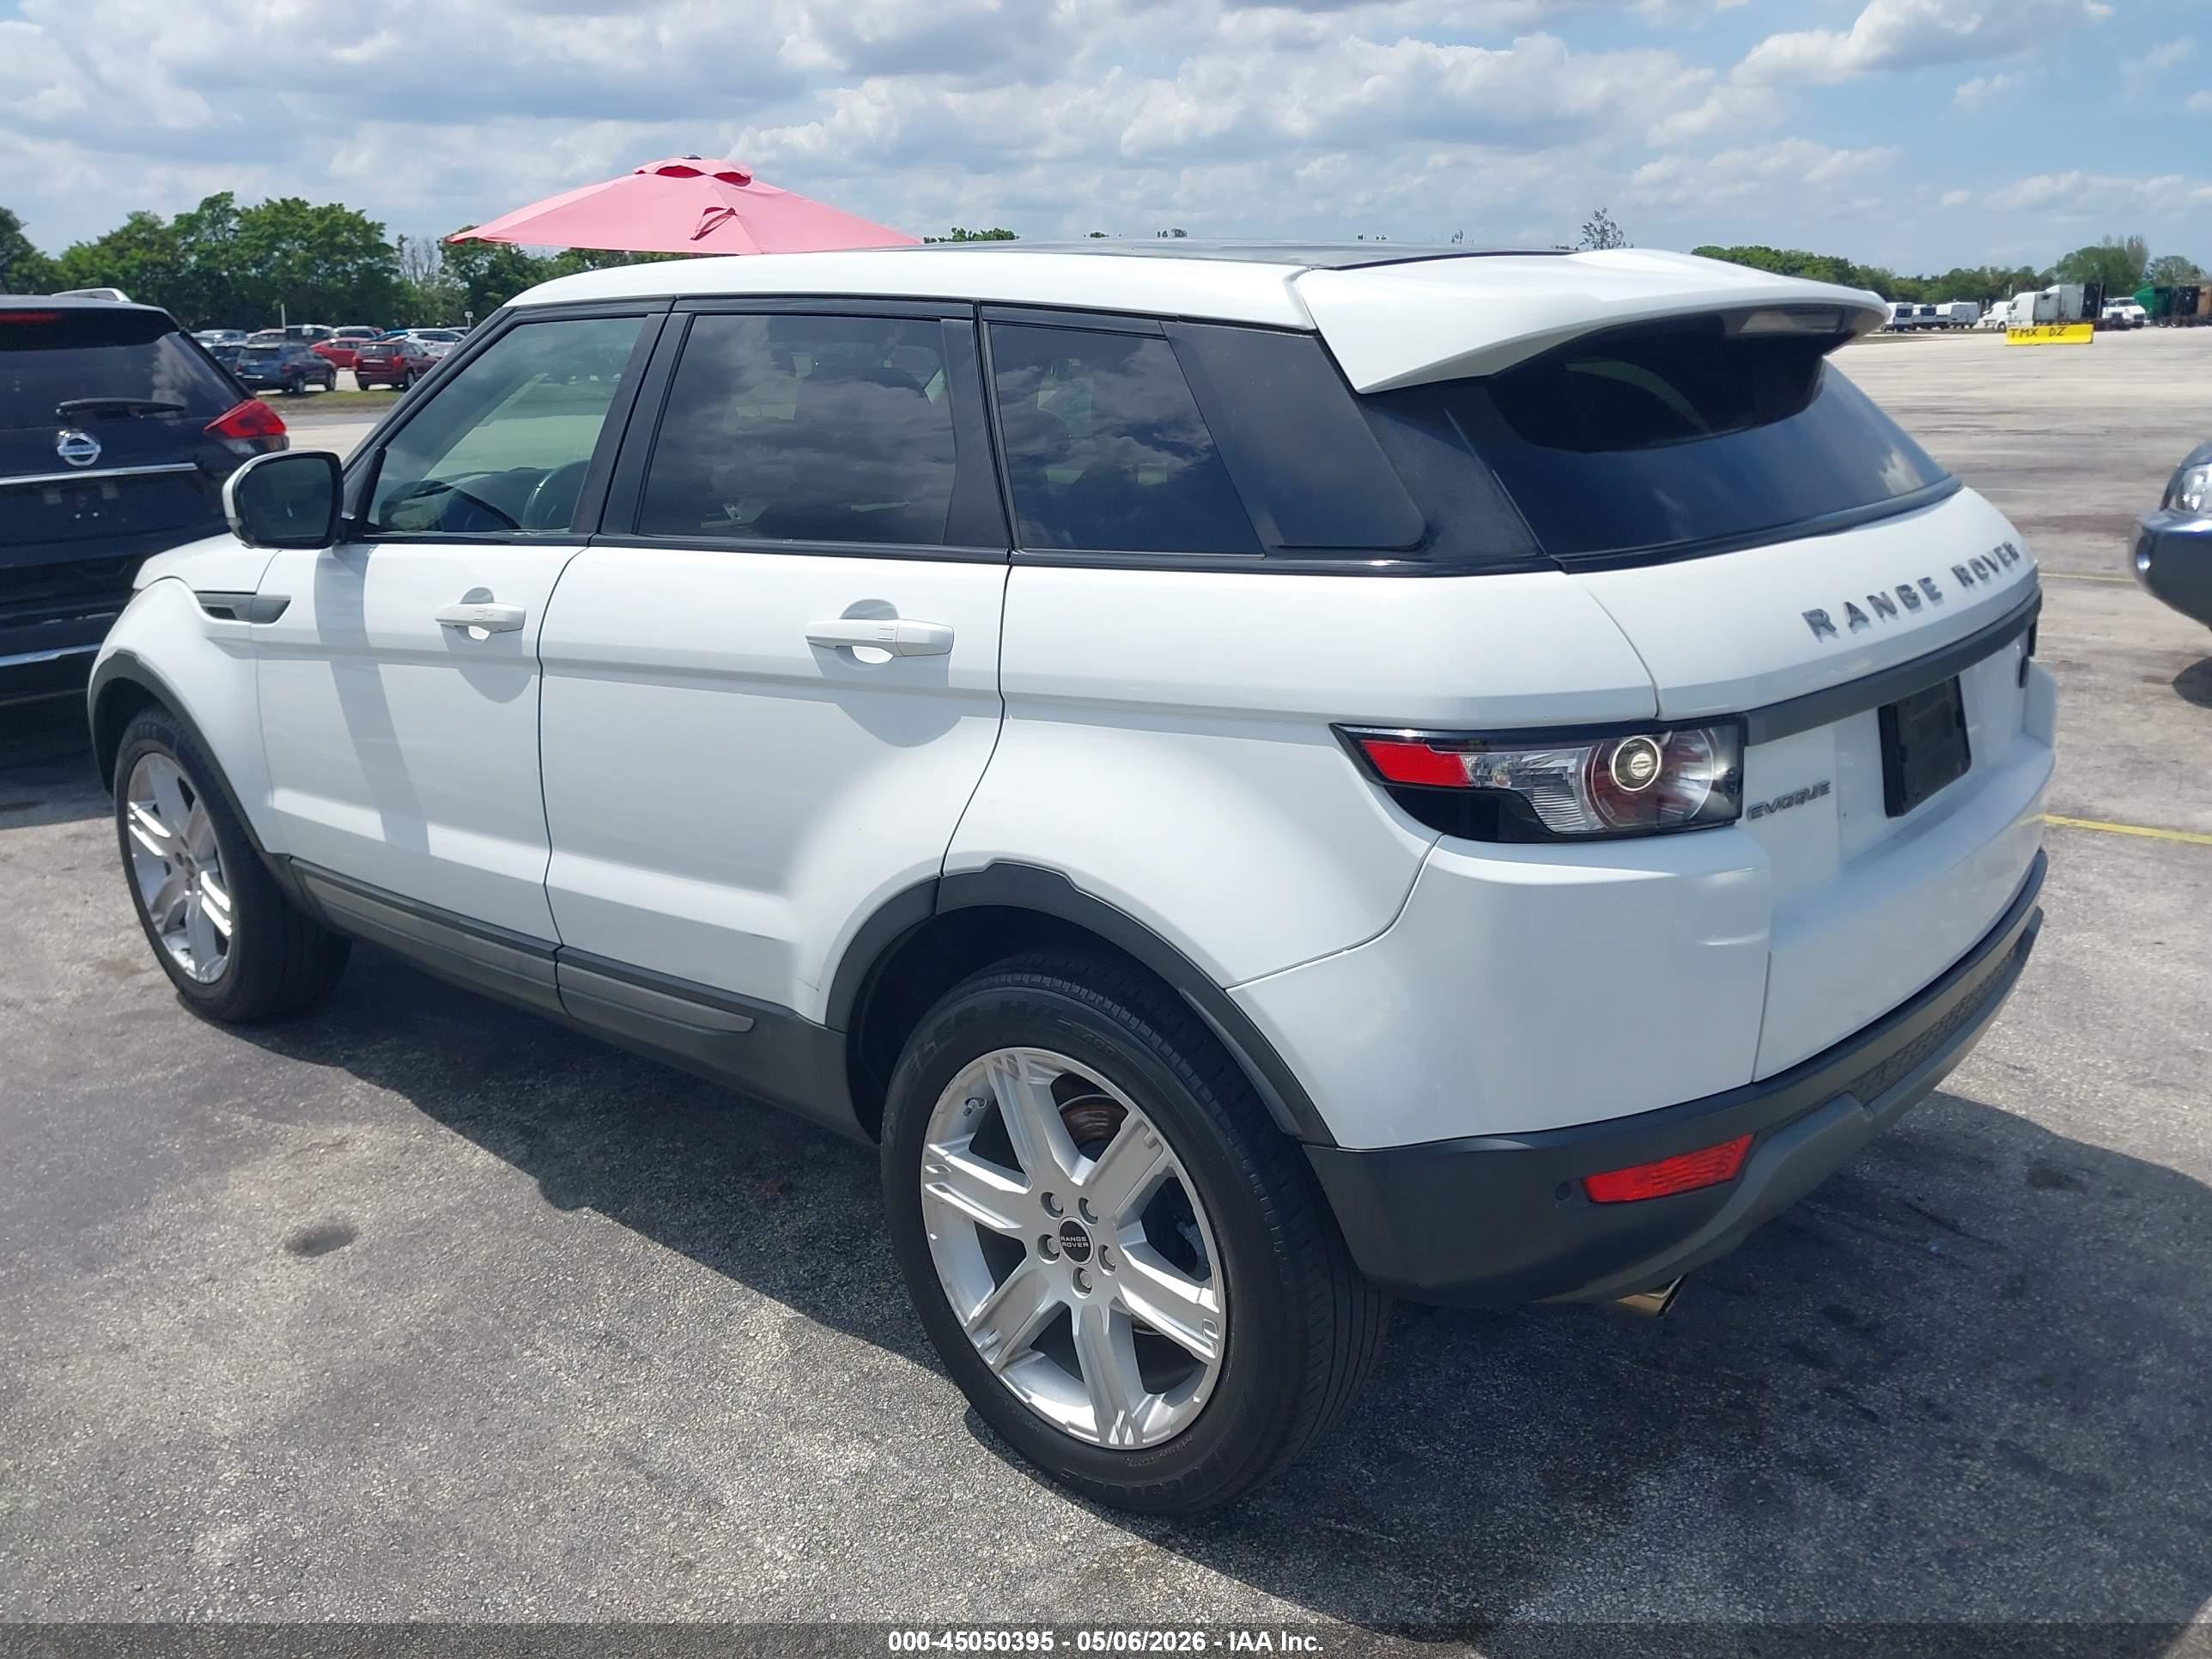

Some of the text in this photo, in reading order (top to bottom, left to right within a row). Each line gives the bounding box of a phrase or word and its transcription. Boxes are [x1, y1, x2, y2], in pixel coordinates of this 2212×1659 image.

[1802, 541, 2021, 640] RANGE ROVER
[1746, 780, 1831, 821] EVOQUE
